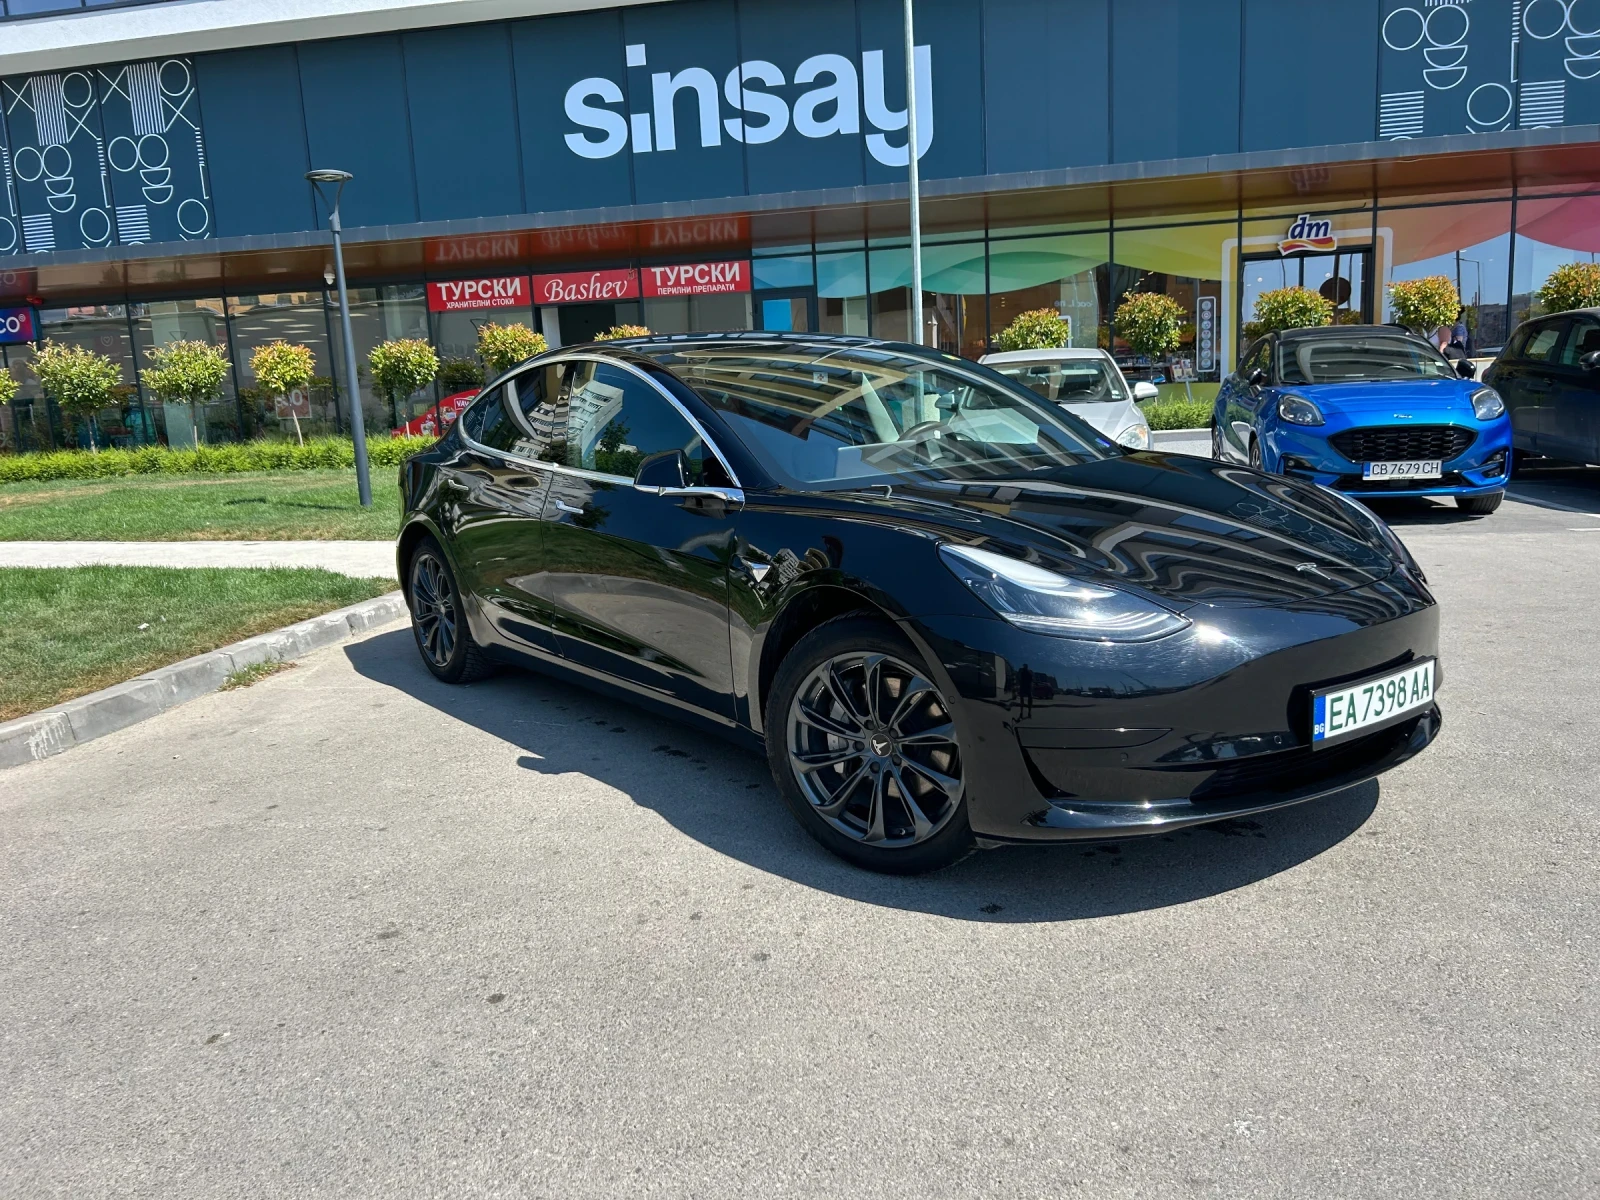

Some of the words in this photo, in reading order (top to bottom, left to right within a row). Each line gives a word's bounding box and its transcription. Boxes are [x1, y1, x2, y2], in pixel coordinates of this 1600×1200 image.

[564, 44, 933, 167] sinsay
[1290, 216, 1330, 239] dm
[651, 262, 740, 286] ТУРСКИ
[437, 278, 521, 300] ТУРСКИ
[544, 272, 628, 302] Bashev
[657, 286, 691, 295] ПЕРИЛНИ
[693, 283, 735, 293] ПРЕПАРАТИ
[446, 299, 490, 309] ХРАНИТЕЛНИ
[492, 298, 514, 306] СТОКИ
[1372, 463, 1388, 475] CB
[1390, 462, 1420, 475] 7679
[1422, 462, 1439, 474] CH
[1329, 692, 1358, 732] EA
[1362, 675, 1407, 722] 7398
[1410, 666, 1430, 704] AA
[1314, 722, 1325, 735] BG
